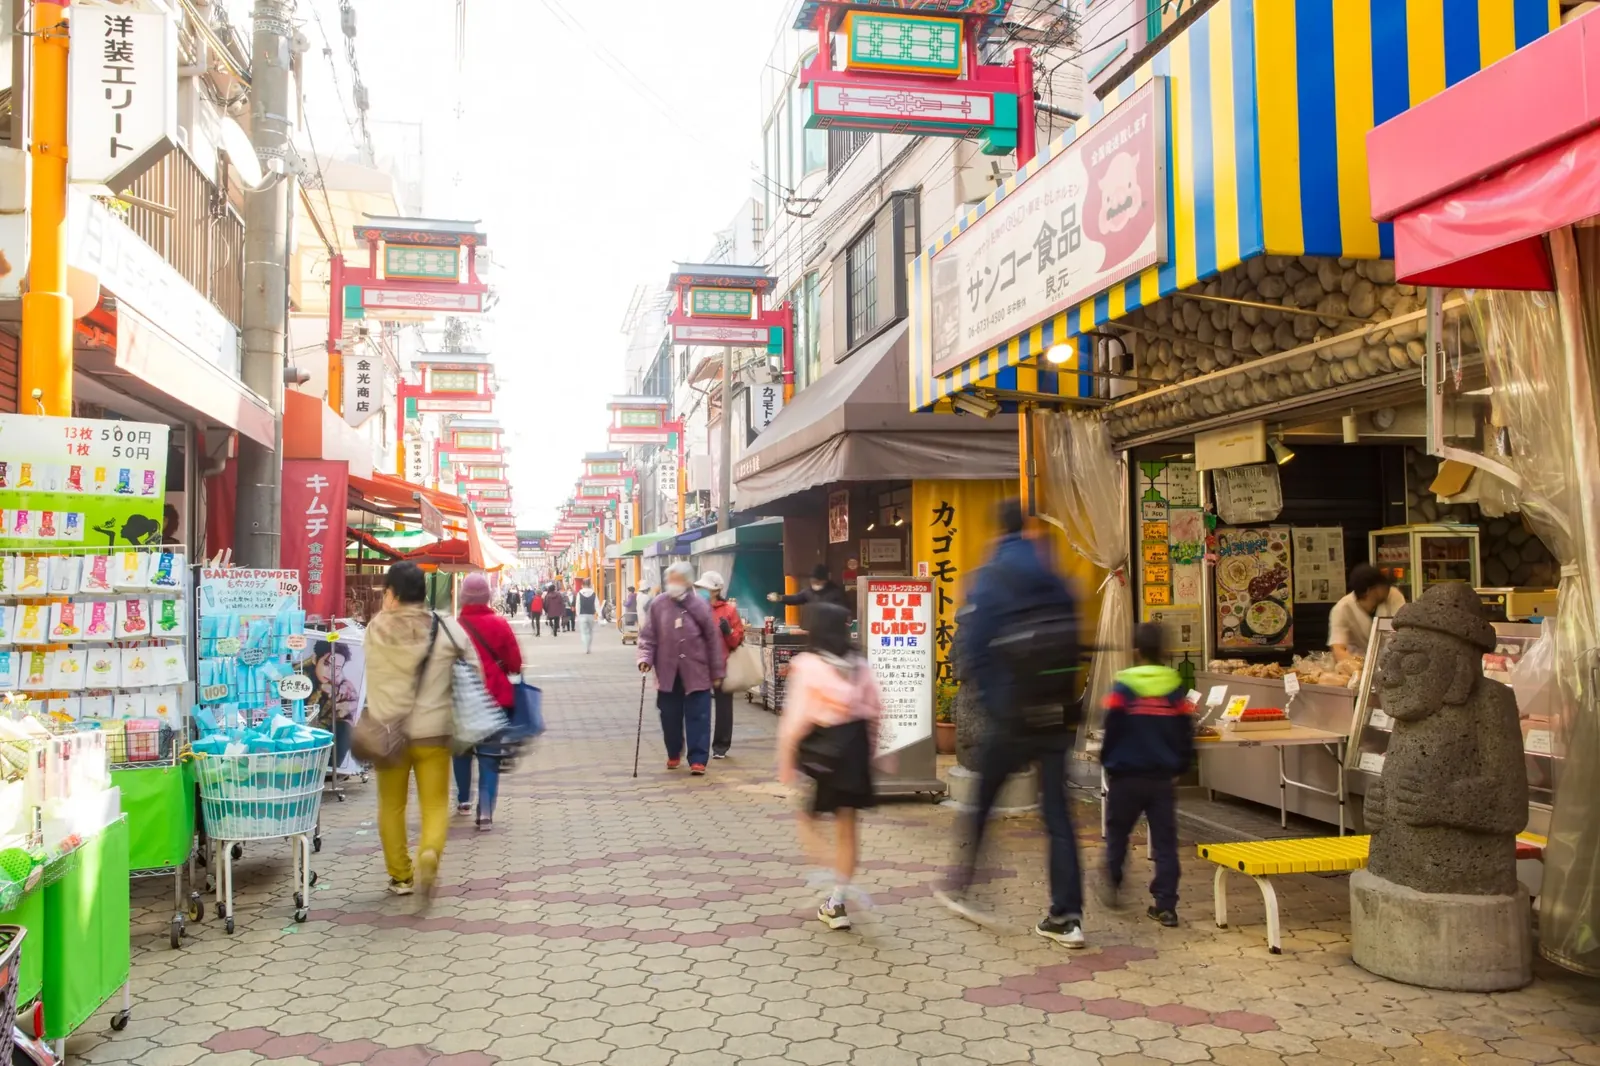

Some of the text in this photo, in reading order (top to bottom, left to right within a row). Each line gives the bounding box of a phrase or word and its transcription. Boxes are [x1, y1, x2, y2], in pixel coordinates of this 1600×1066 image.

[101, 14, 136, 158] 洋装エリート
[966, 202, 1081, 314] サンコー食品
[1045, 267, 1070, 299] 良元
[356, 359, 371, 413] 金光商店
[63, 426, 151, 444] 13枚 500円
[66, 443, 150, 460] 1枚 50円
[305, 474, 329, 538] キムチ
[203, 569, 298, 580] BAKING POWDER
[307, 542, 324, 595] 金光商店
[279, 581, 298, 592] 1100
[881, 636, 918, 647] 専門店
